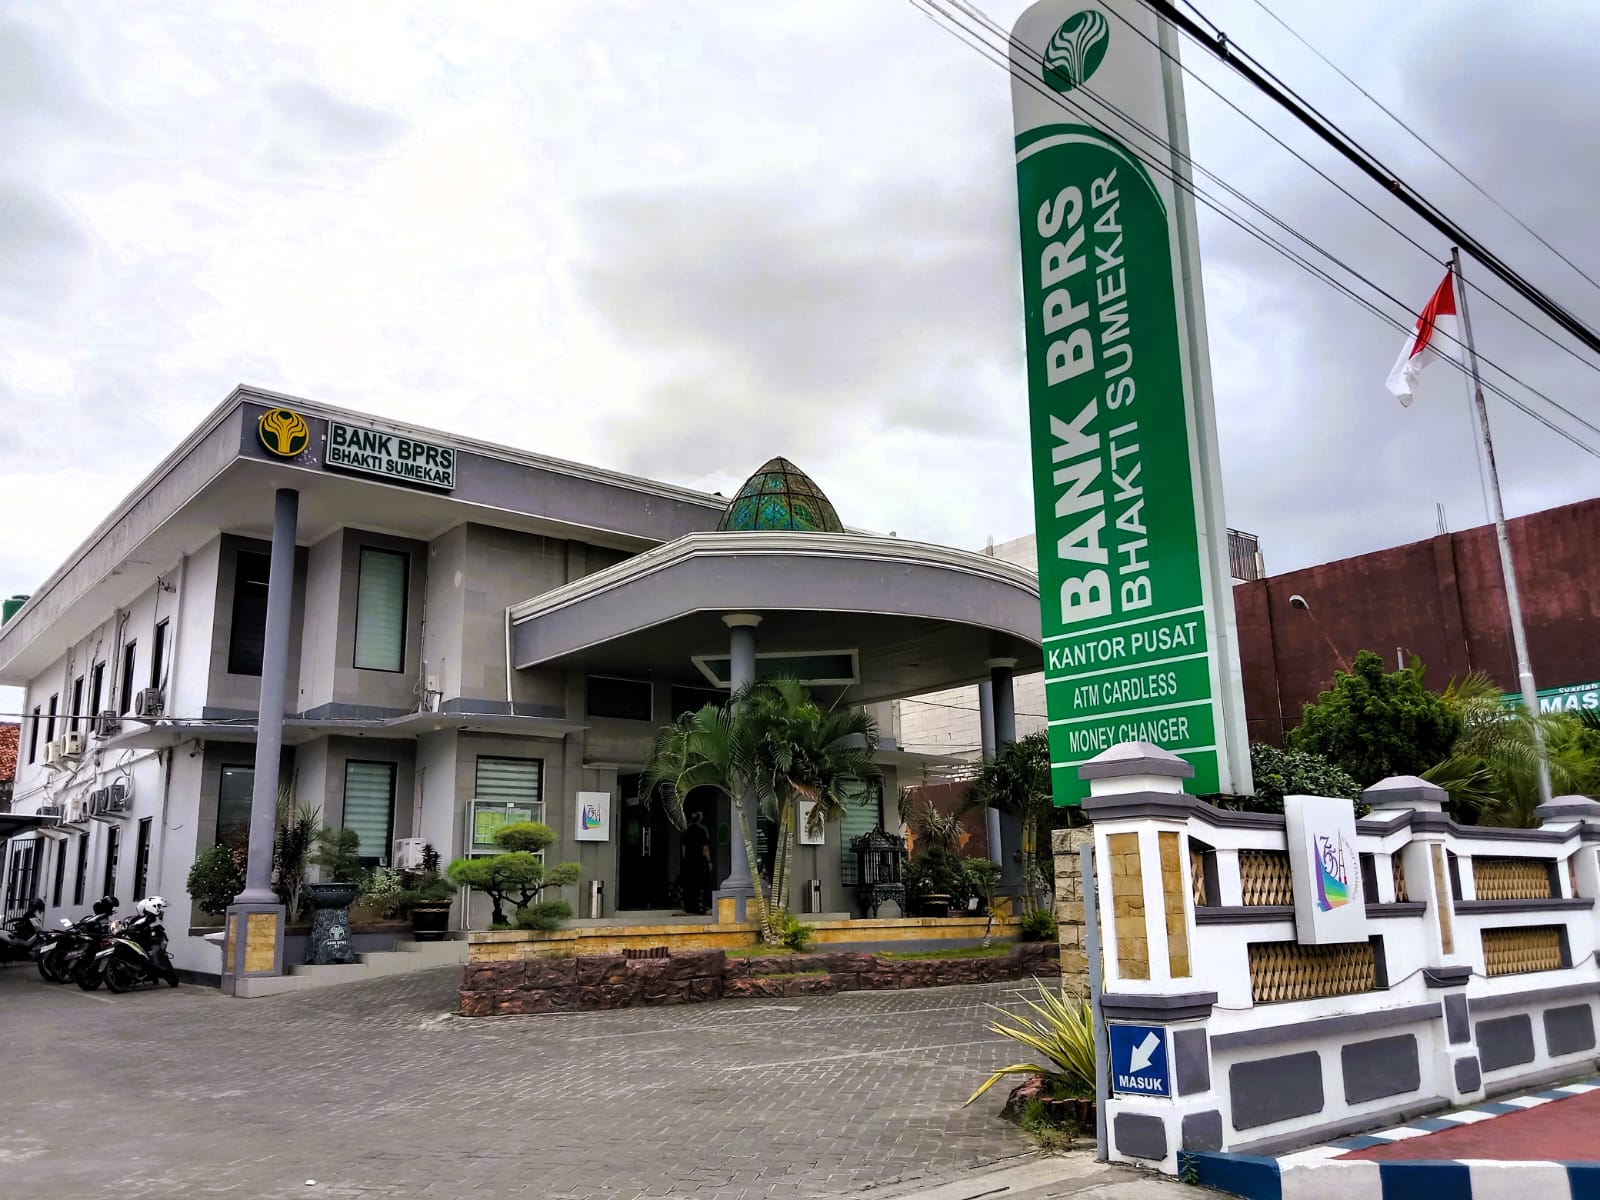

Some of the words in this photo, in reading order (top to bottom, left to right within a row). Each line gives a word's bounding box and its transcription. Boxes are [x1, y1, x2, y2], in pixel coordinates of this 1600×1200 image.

[1037, 185, 1096, 387] BPRS
[1090, 167, 1136, 410] SUMEKAR
[332, 424, 392, 457] BANK
[398, 439, 452, 470] BPRS
[332, 447, 382, 470] BHAKTI
[385, 459, 451, 485] SUMEKAR
[1050, 397, 1112, 625] BANK
[1110, 421, 1152, 613] BHAKTI
[1049, 636, 1125, 671] KANTOR
[1131, 621, 1198, 655] PUSAT
[1073, 682, 1100, 710] ATM
[1102, 671, 1177, 705] CARDLESS
[1558, 682, 1598, 696] Syariah
[1069, 725, 1116, 753] MONEY
[1118, 716, 1190, 744] CHANGER
[1119, 1074, 1163, 1091] MASUK
